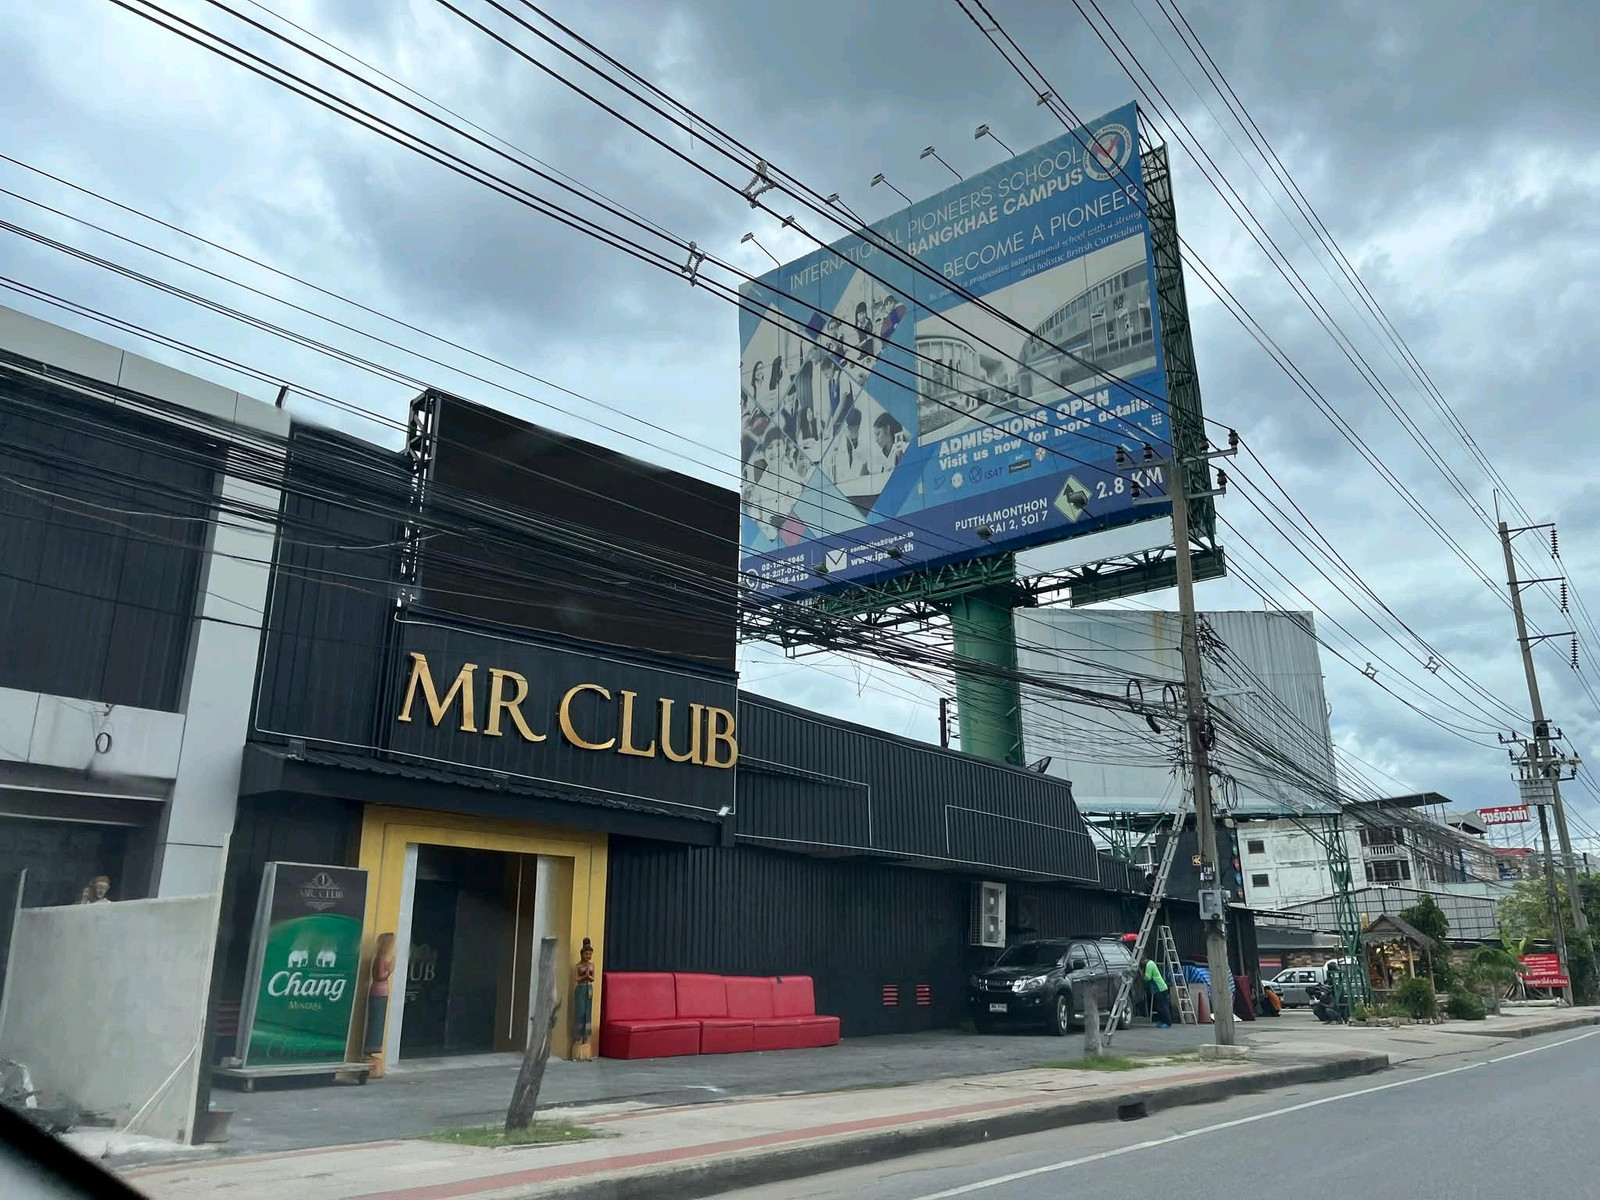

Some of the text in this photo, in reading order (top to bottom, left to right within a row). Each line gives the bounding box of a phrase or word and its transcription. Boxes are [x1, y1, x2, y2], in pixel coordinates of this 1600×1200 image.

[908, 187, 993, 239] PIONEERS
[998, 147, 1082, 198] SCHOOL
[908, 168, 1084, 256] BANGKHAE CAMPUS
[943, 184, 1140, 280] BECOME A PIONEER
[1011, 242, 1060, 269] international
[1062, 229, 1086, 248] school
[1087, 223, 1106, 237] with
[1114, 210, 1141, 225] strong
[1066, 241, 1093, 259] British
[1095, 223, 1143, 247] Curriculum
[939, 410, 1049, 457] ADMISSIONS
[1056, 389, 1110, 420] OPEN
[939, 453, 968, 471] Visit
[973, 449, 989, 462] us
[994, 439, 1022, 455] now
[1028, 430, 1049, 443] for
[1054, 417, 1091, 437] more
[1096, 466, 1164, 499] 2.8 KM
[955, 498, 1048, 531] PUTTHAMONTHON
[989, 510, 1049, 534] SAI 2, SOI 7
[397, 651, 739, 769] MR CLUB
[267, 970, 348, 1001] Chang
